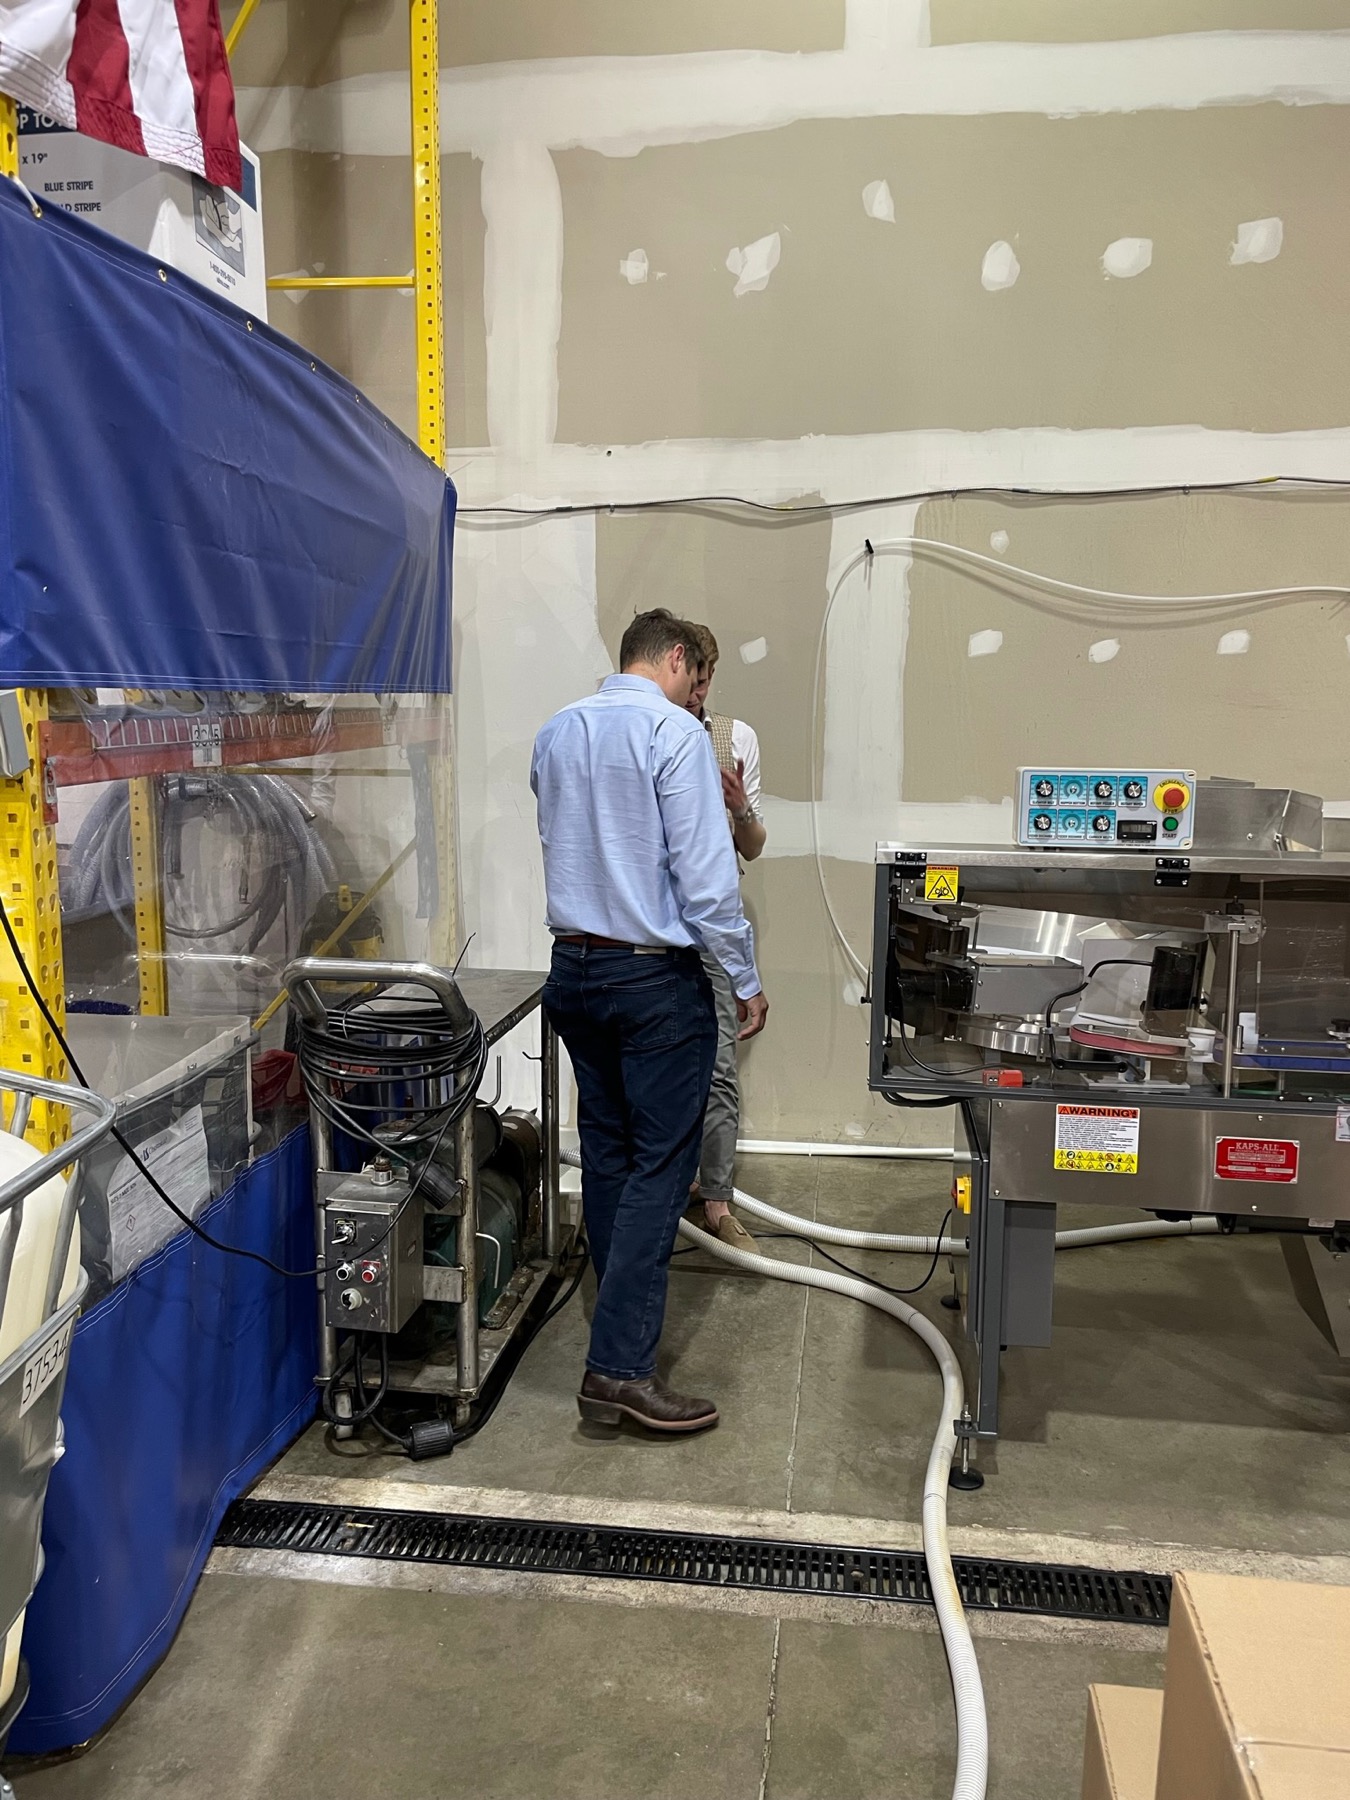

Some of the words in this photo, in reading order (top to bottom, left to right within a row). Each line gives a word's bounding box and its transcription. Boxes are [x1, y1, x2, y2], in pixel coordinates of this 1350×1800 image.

[22, 155, 28, 165] x
[31, 152, 48, 164] 19"
[44, 181, 65, 192] BLUE
[66, 180, 94, 191] STRIPE
[74, 202, 102, 212] STRIPE
[1069, 1106, 1130, 1119] WARNING
[1235, 1142, 1281, 1152] KAPS-ALL
[22, 1329, 69, 1405] 37534
